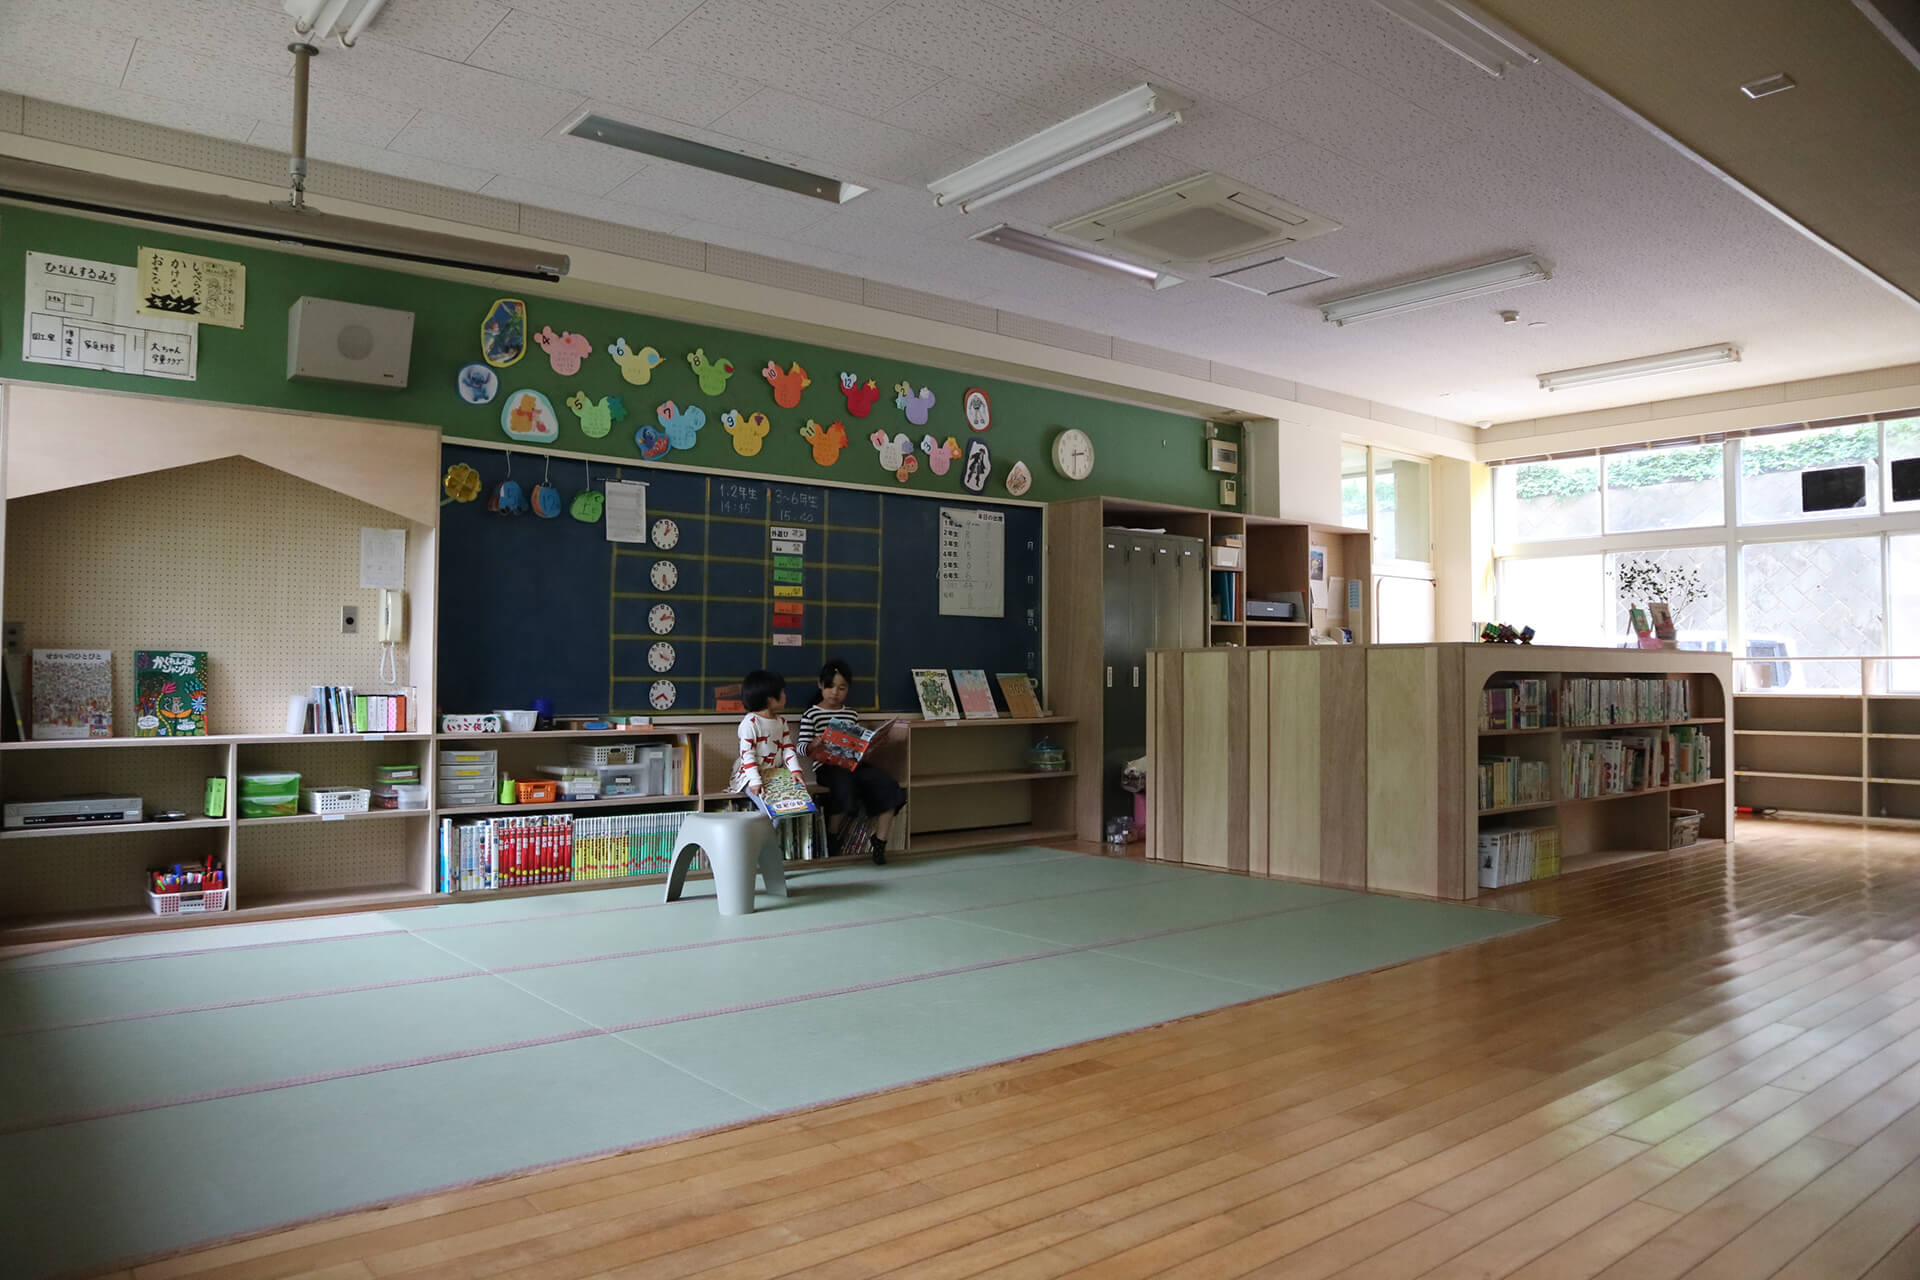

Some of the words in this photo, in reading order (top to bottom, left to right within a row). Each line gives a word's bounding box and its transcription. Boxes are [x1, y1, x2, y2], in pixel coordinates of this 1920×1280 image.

[44, 262, 117, 282] ひなんするみち
[542, 335, 551, 345] 4
[616, 346, 625, 356] 6
[694, 356, 702, 367] 8
[767, 369, 777, 378] 10
[844, 378, 853, 388] 12
[574, 399, 583, 410] 5
[663, 407, 672, 419] 7
[727, 416, 735, 427] 9
[806, 427, 815, 437] 11
[943, 530, 958, 538] 2年生
